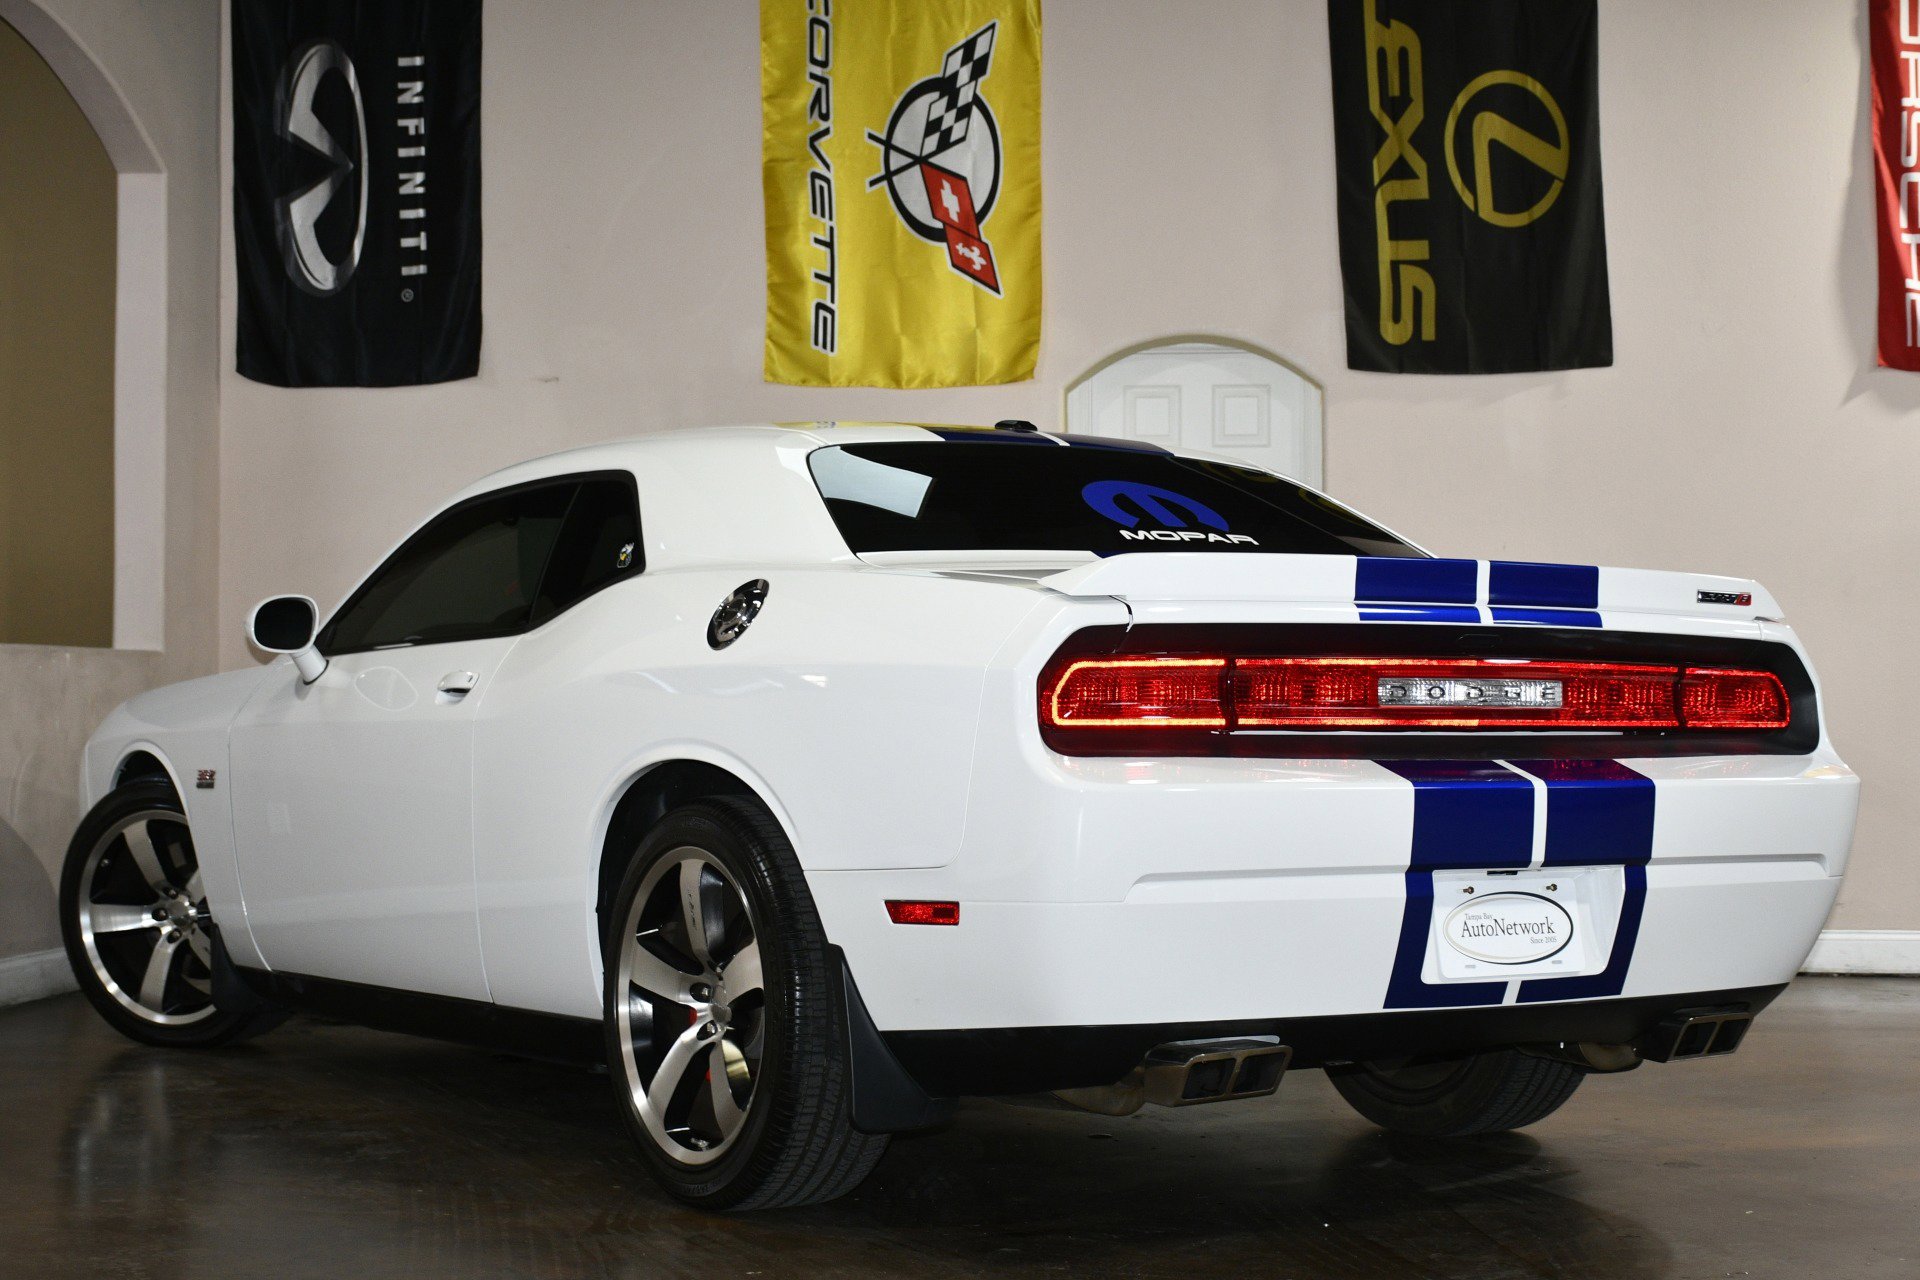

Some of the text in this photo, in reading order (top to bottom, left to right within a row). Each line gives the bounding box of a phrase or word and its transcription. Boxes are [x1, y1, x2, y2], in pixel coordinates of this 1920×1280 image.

[397, 55, 427, 276] INFINITI
[1363, 0, 1436, 346] EXUS
[807, 0, 836, 355] ORVETTE
[1119, 529, 1259, 546] MOPAR
[1388, 684, 1557, 701] DODGE
[1461, 916, 1555, 938] AutoNetwork
[1483, 912, 1493, 920] Bay
